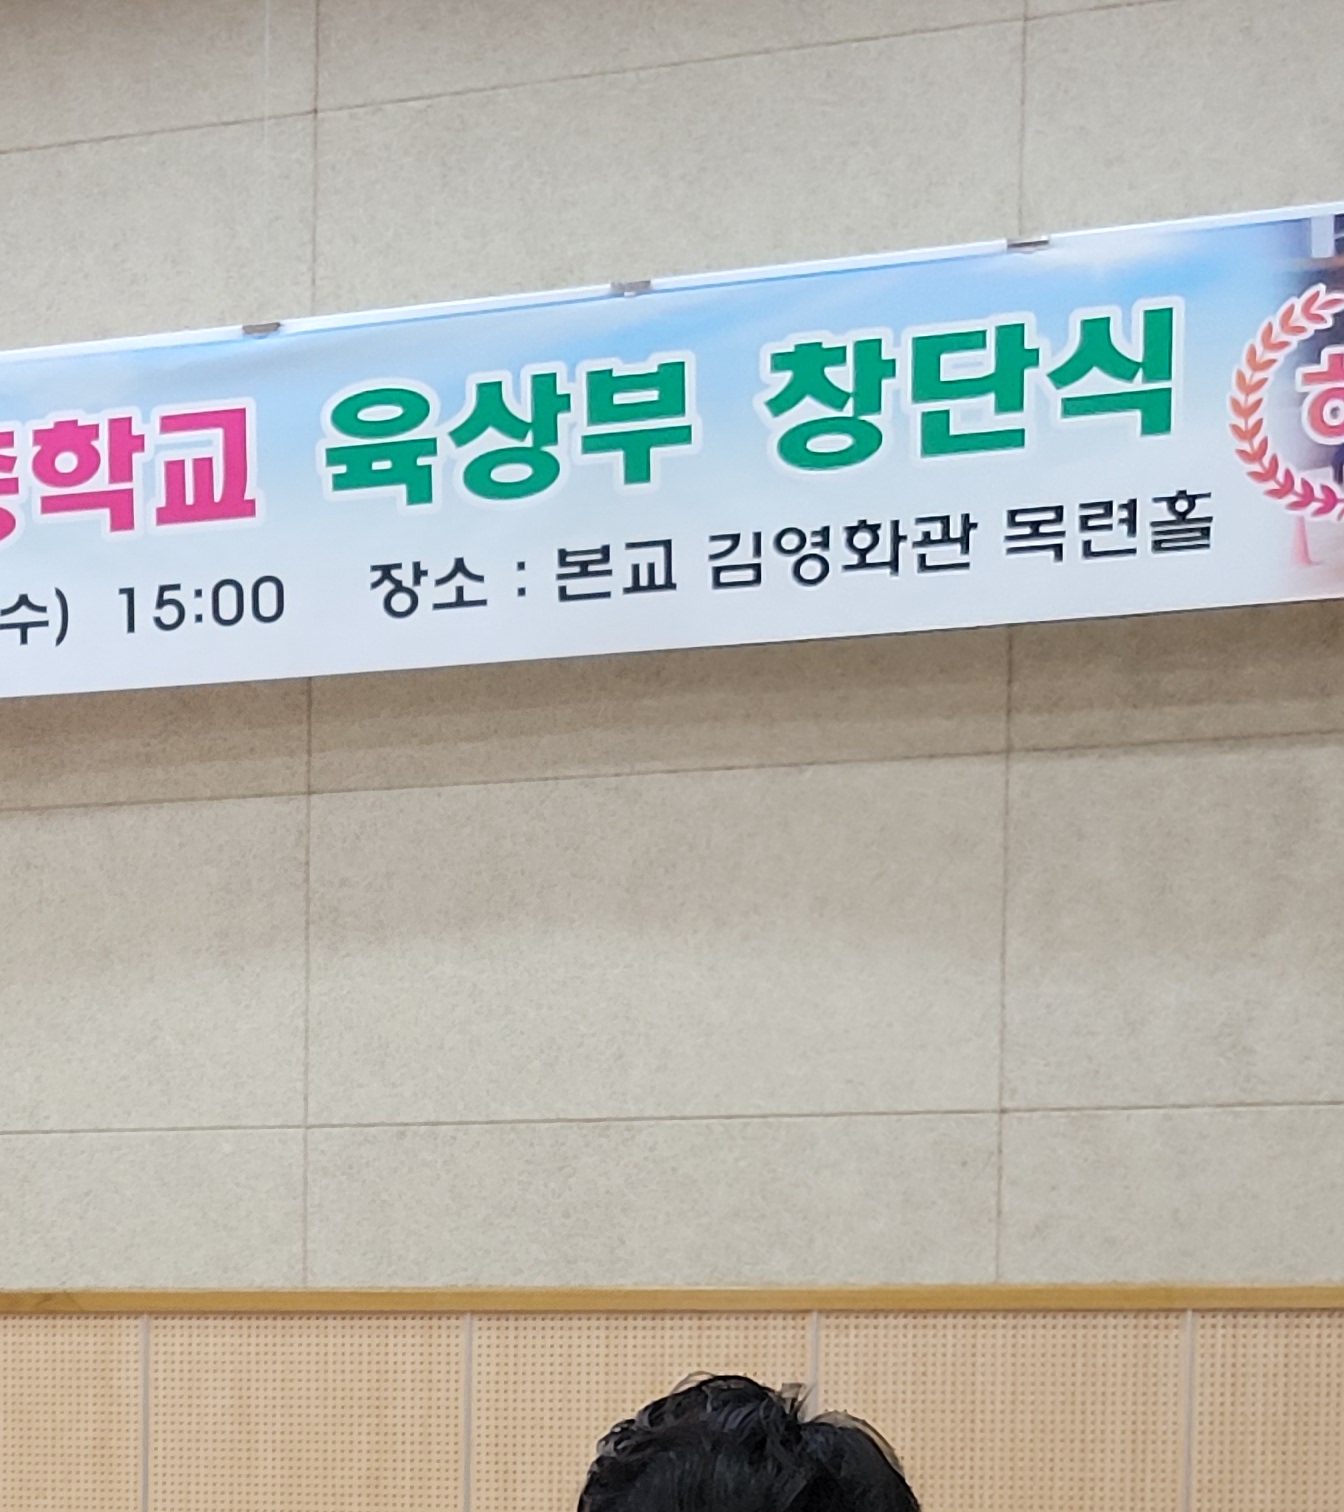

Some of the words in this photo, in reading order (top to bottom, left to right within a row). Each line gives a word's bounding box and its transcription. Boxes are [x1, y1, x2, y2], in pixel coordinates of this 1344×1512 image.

[325, 360, 693, 506] 육상부
[765, 306, 1175, 471] 창단식
[118, 575, 286, 634] 15:00
[370, 556, 488, 619] 장소
[556, 538, 678, 602] 본교
[708, 512, 979, 589] 김영화관
[1004, 489, 1214, 562] 목련홀
